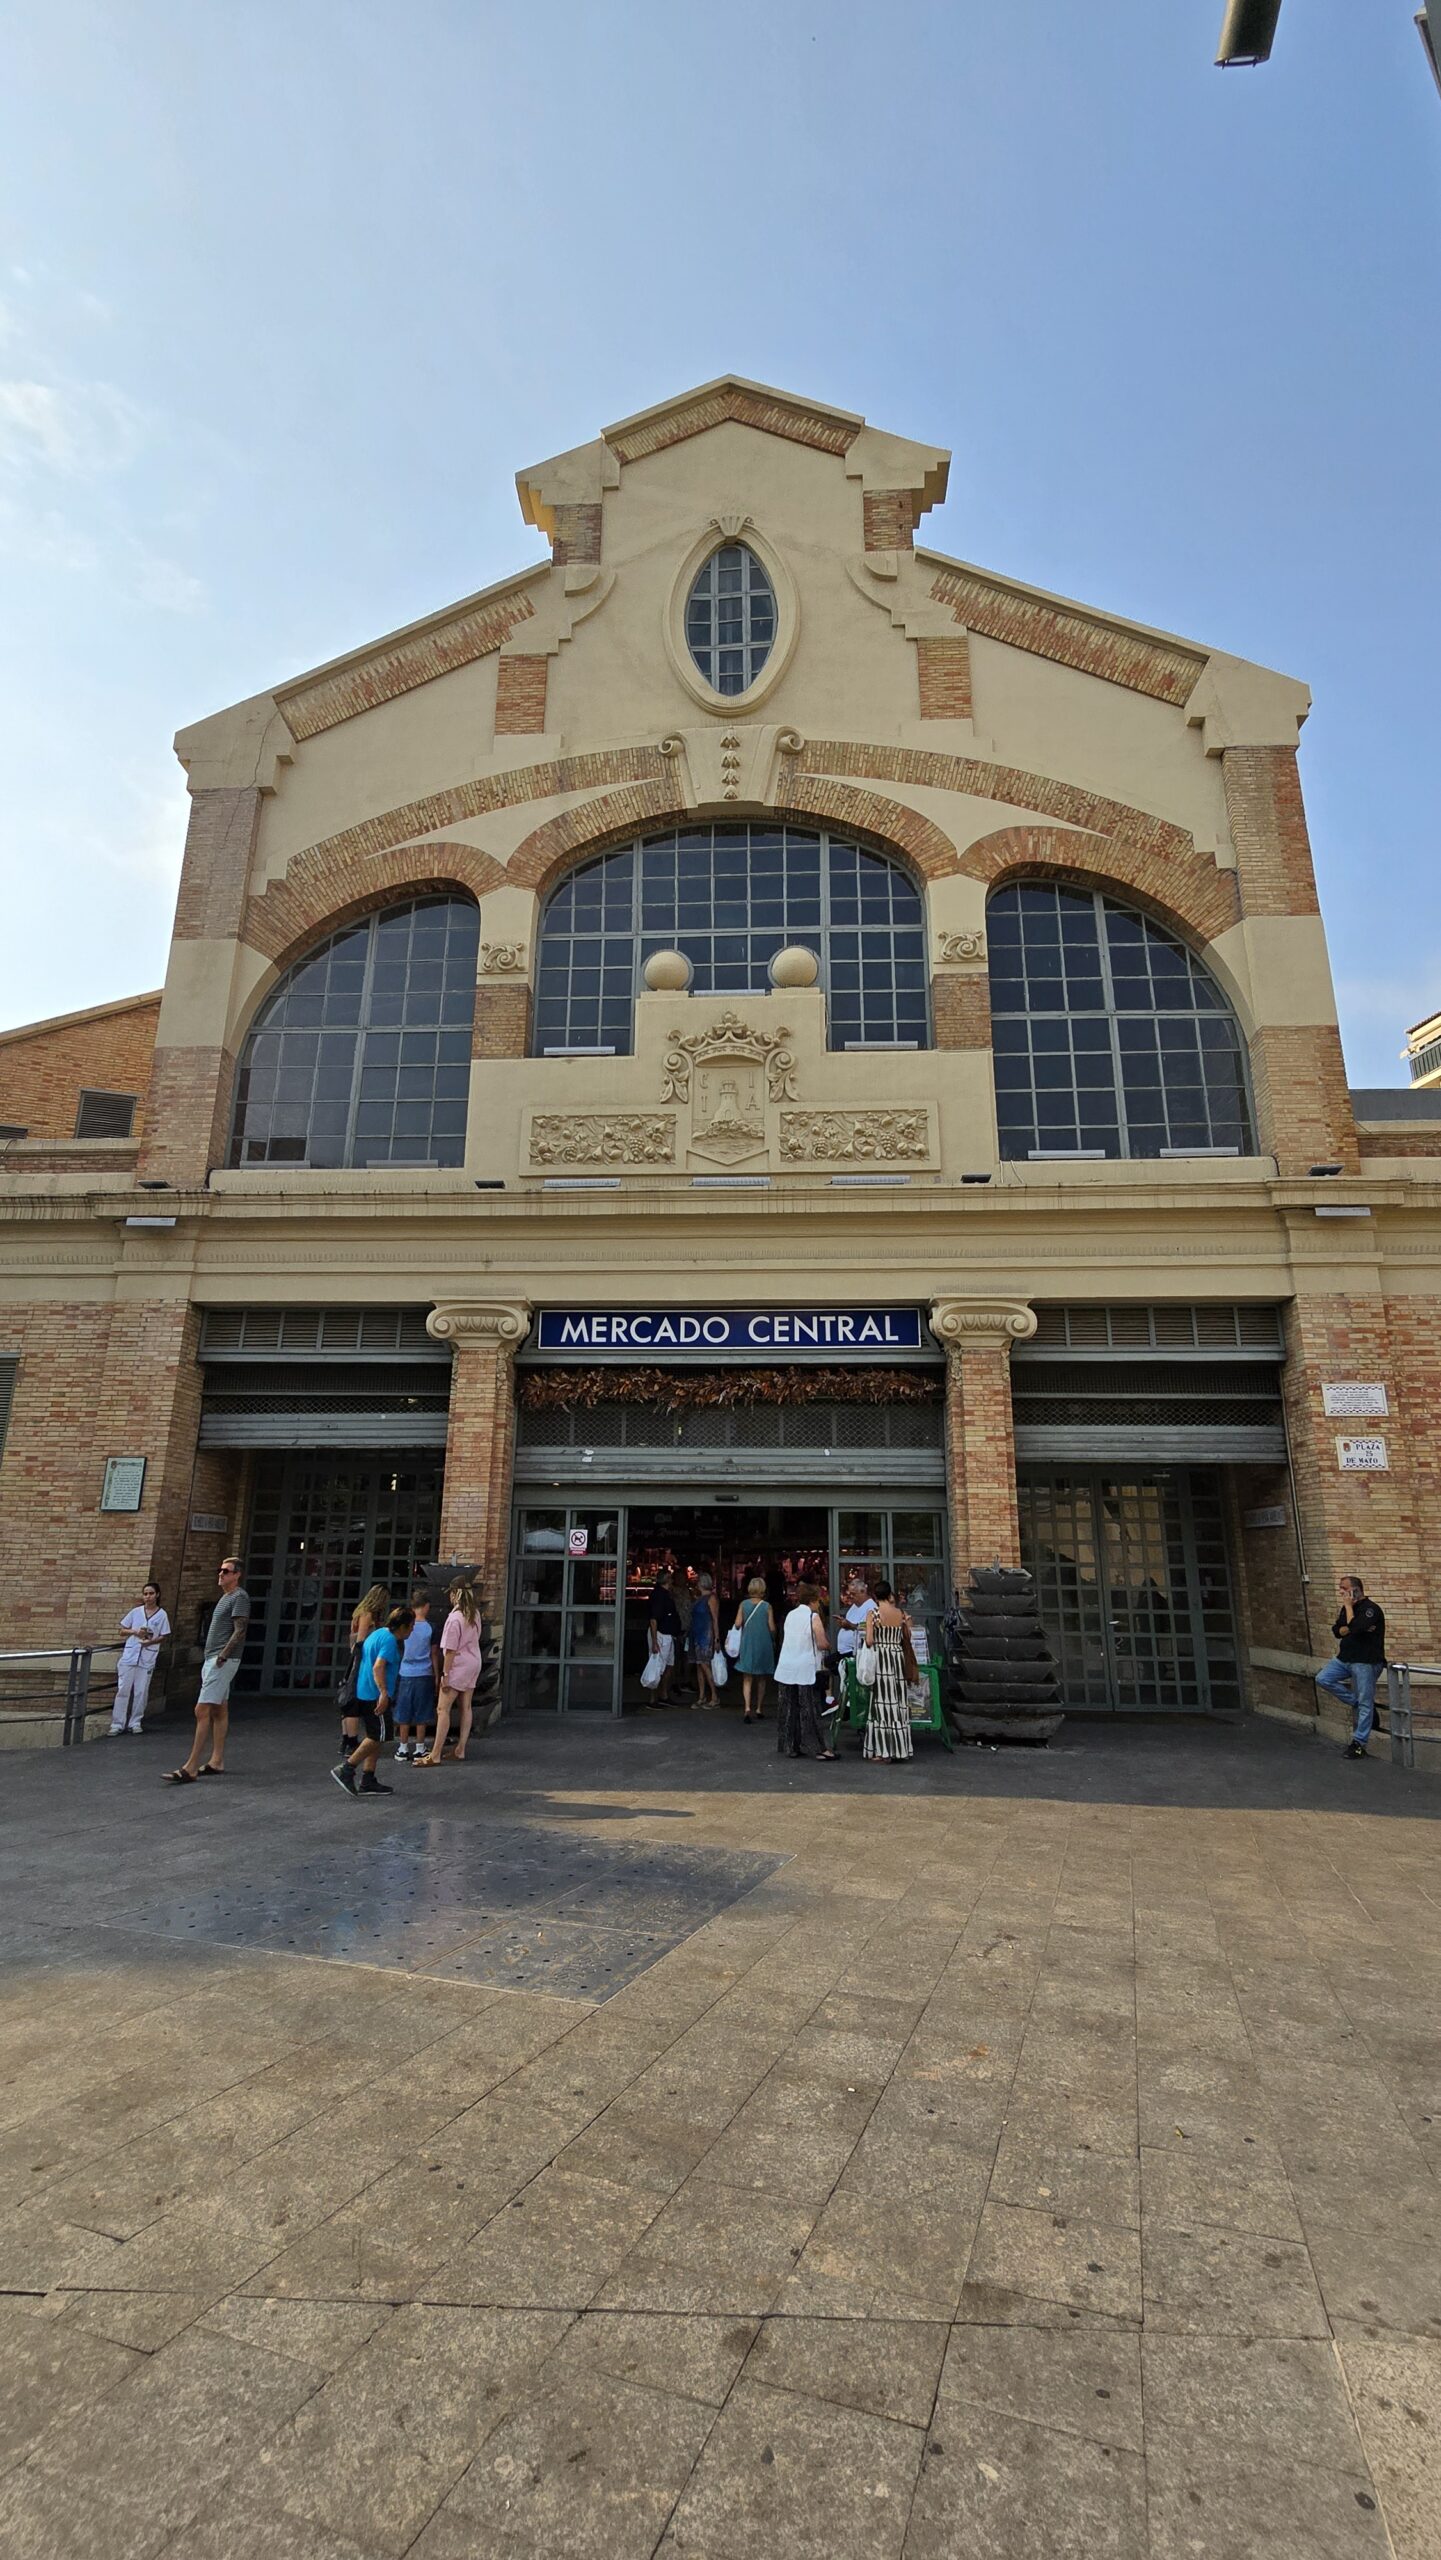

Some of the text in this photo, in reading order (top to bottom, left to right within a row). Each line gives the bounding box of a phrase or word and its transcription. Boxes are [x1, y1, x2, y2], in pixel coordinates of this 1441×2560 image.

[745, 1095, 760, 1111] A
[560, 1315, 899, 1343] MERCADO CENTRAL
